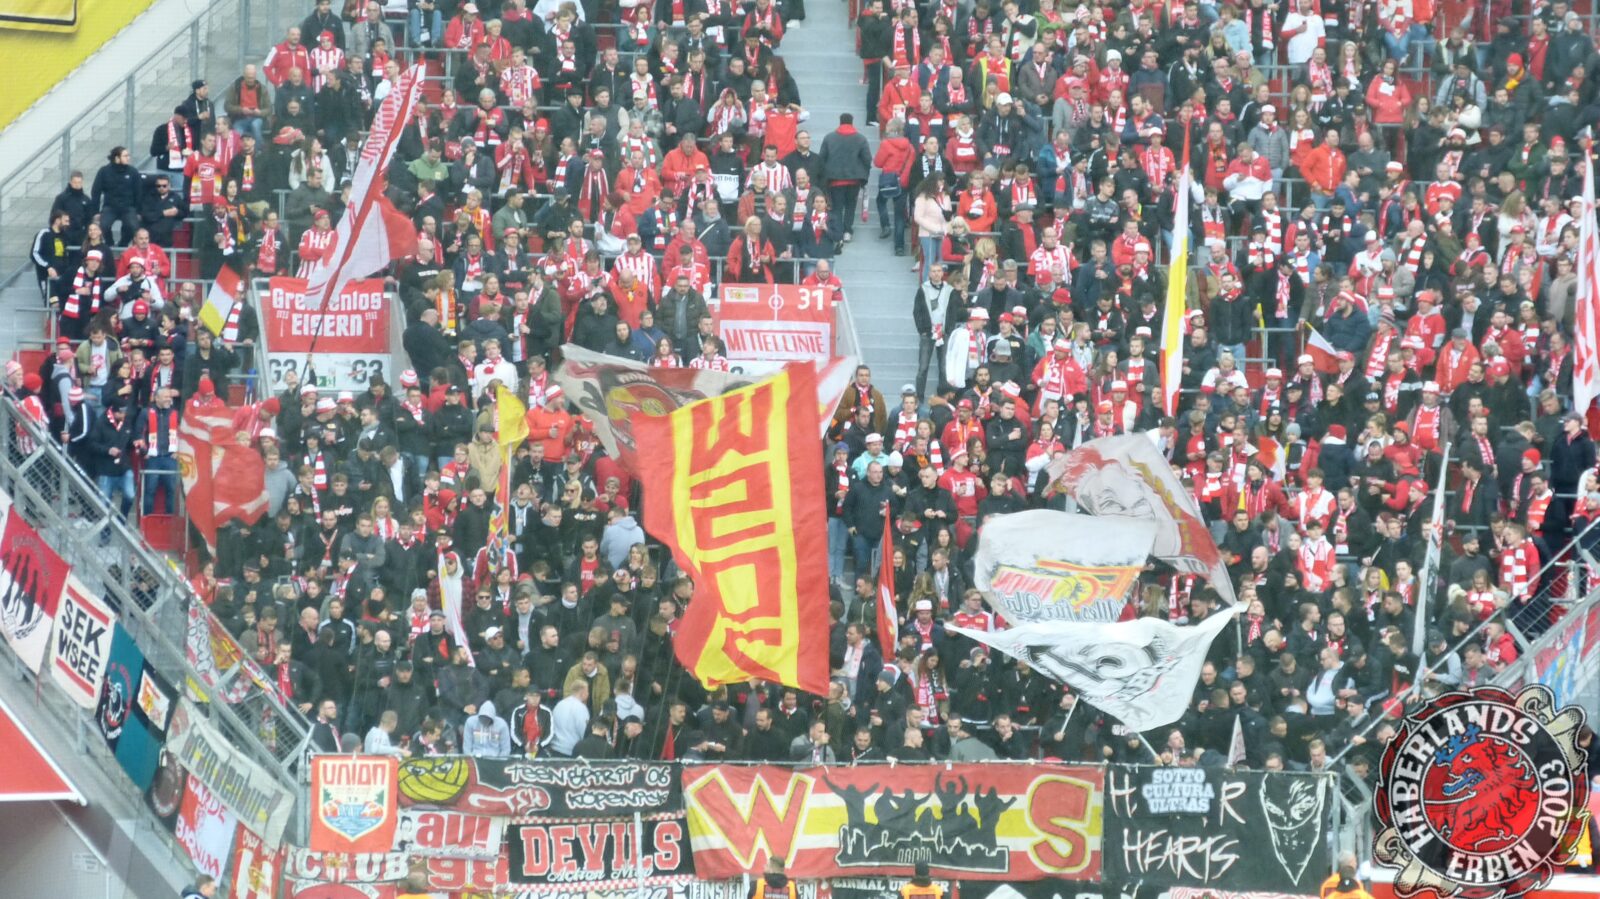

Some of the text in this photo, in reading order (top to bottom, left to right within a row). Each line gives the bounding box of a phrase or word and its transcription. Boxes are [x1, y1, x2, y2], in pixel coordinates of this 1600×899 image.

[798, 288, 824, 311] 31
[291, 313, 363, 337] EISERN
[725, 328, 826, 354] MITTELLINIE
[61, 598, 107, 657] SEK
[58, 628, 100, 685] WSEE
[1152, 768, 1206, 784] SOTTO
[1141, 783, 1216, 799] CULTURA
[1148, 797, 1210, 813] ULTRAS
[687, 767, 1095, 873] W S
[520, 821, 682, 876] DEVILS
[1122, 828, 1240, 885] HEARTS
